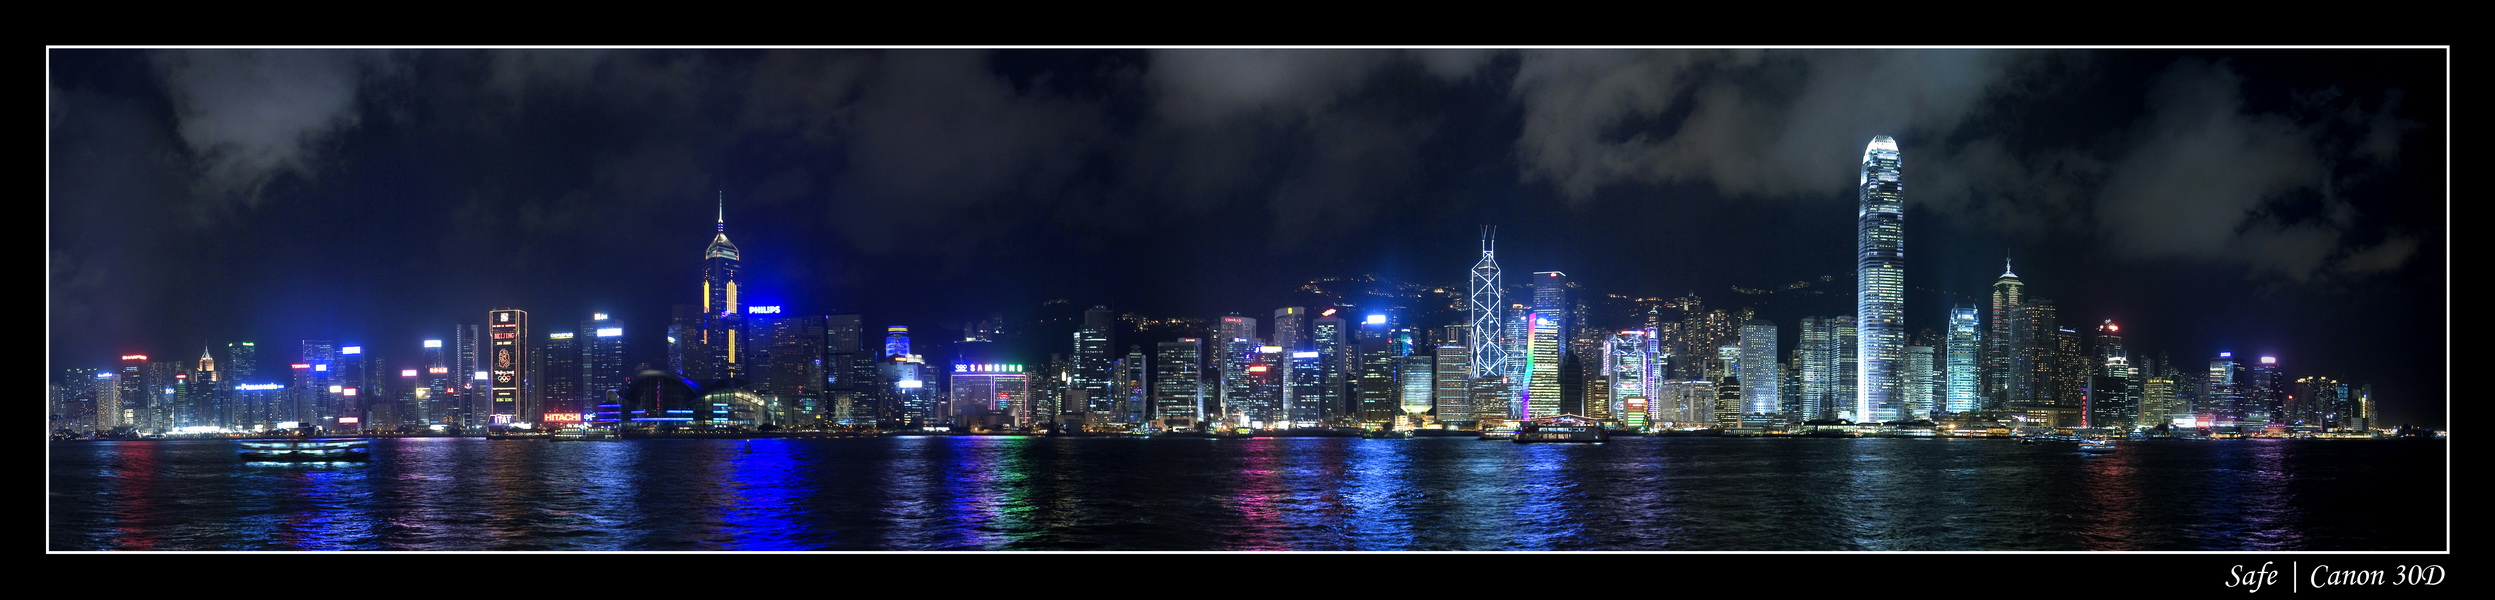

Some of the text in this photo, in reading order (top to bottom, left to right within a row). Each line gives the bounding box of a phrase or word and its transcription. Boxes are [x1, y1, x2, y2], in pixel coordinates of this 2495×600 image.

[749, 306, 780, 314] PHILIPS
[970, 364, 1023, 372] SAMSUNG
[545, 413, 581, 421] HITACHI
